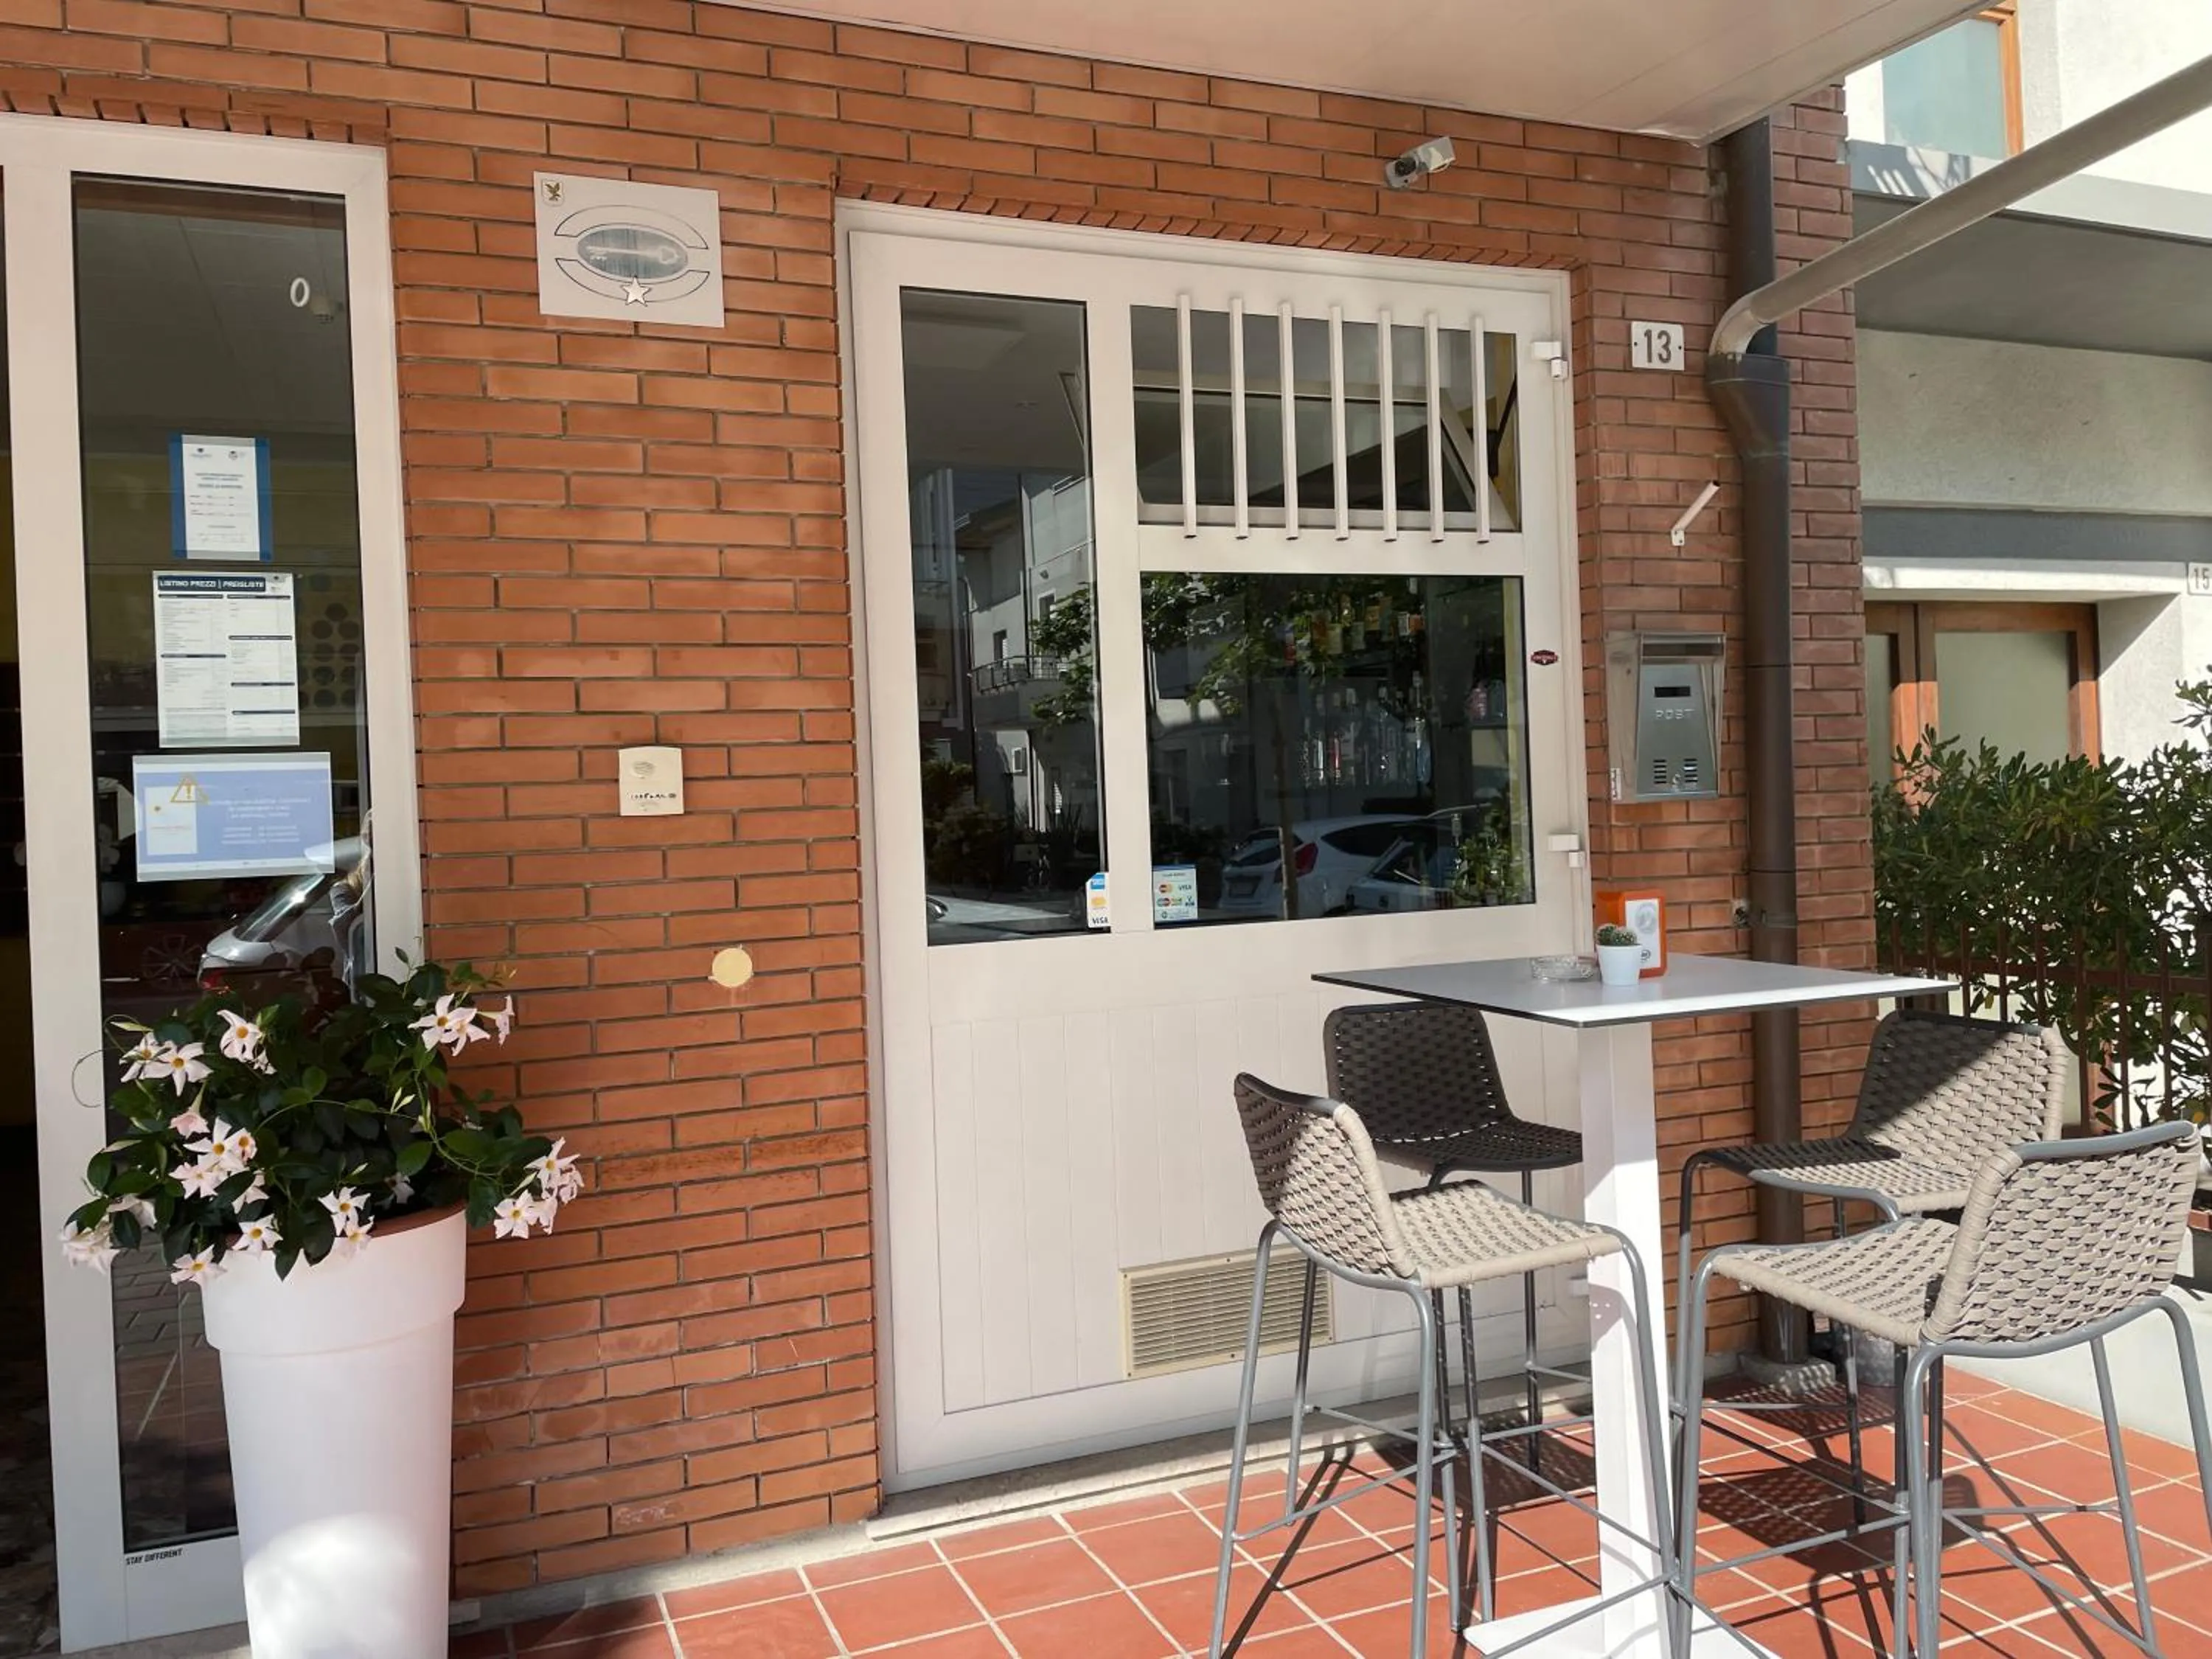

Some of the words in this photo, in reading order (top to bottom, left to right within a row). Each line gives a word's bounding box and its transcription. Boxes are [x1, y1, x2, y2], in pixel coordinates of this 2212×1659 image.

[1644, 329, 1672, 364] 13
[2194, 567, 2210, 590] 15
[1655, 709, 1695, 720] POST
[126, 1556, 143, 1565] STAY
[145, 1548, 184, 1562] DIFFERENT
